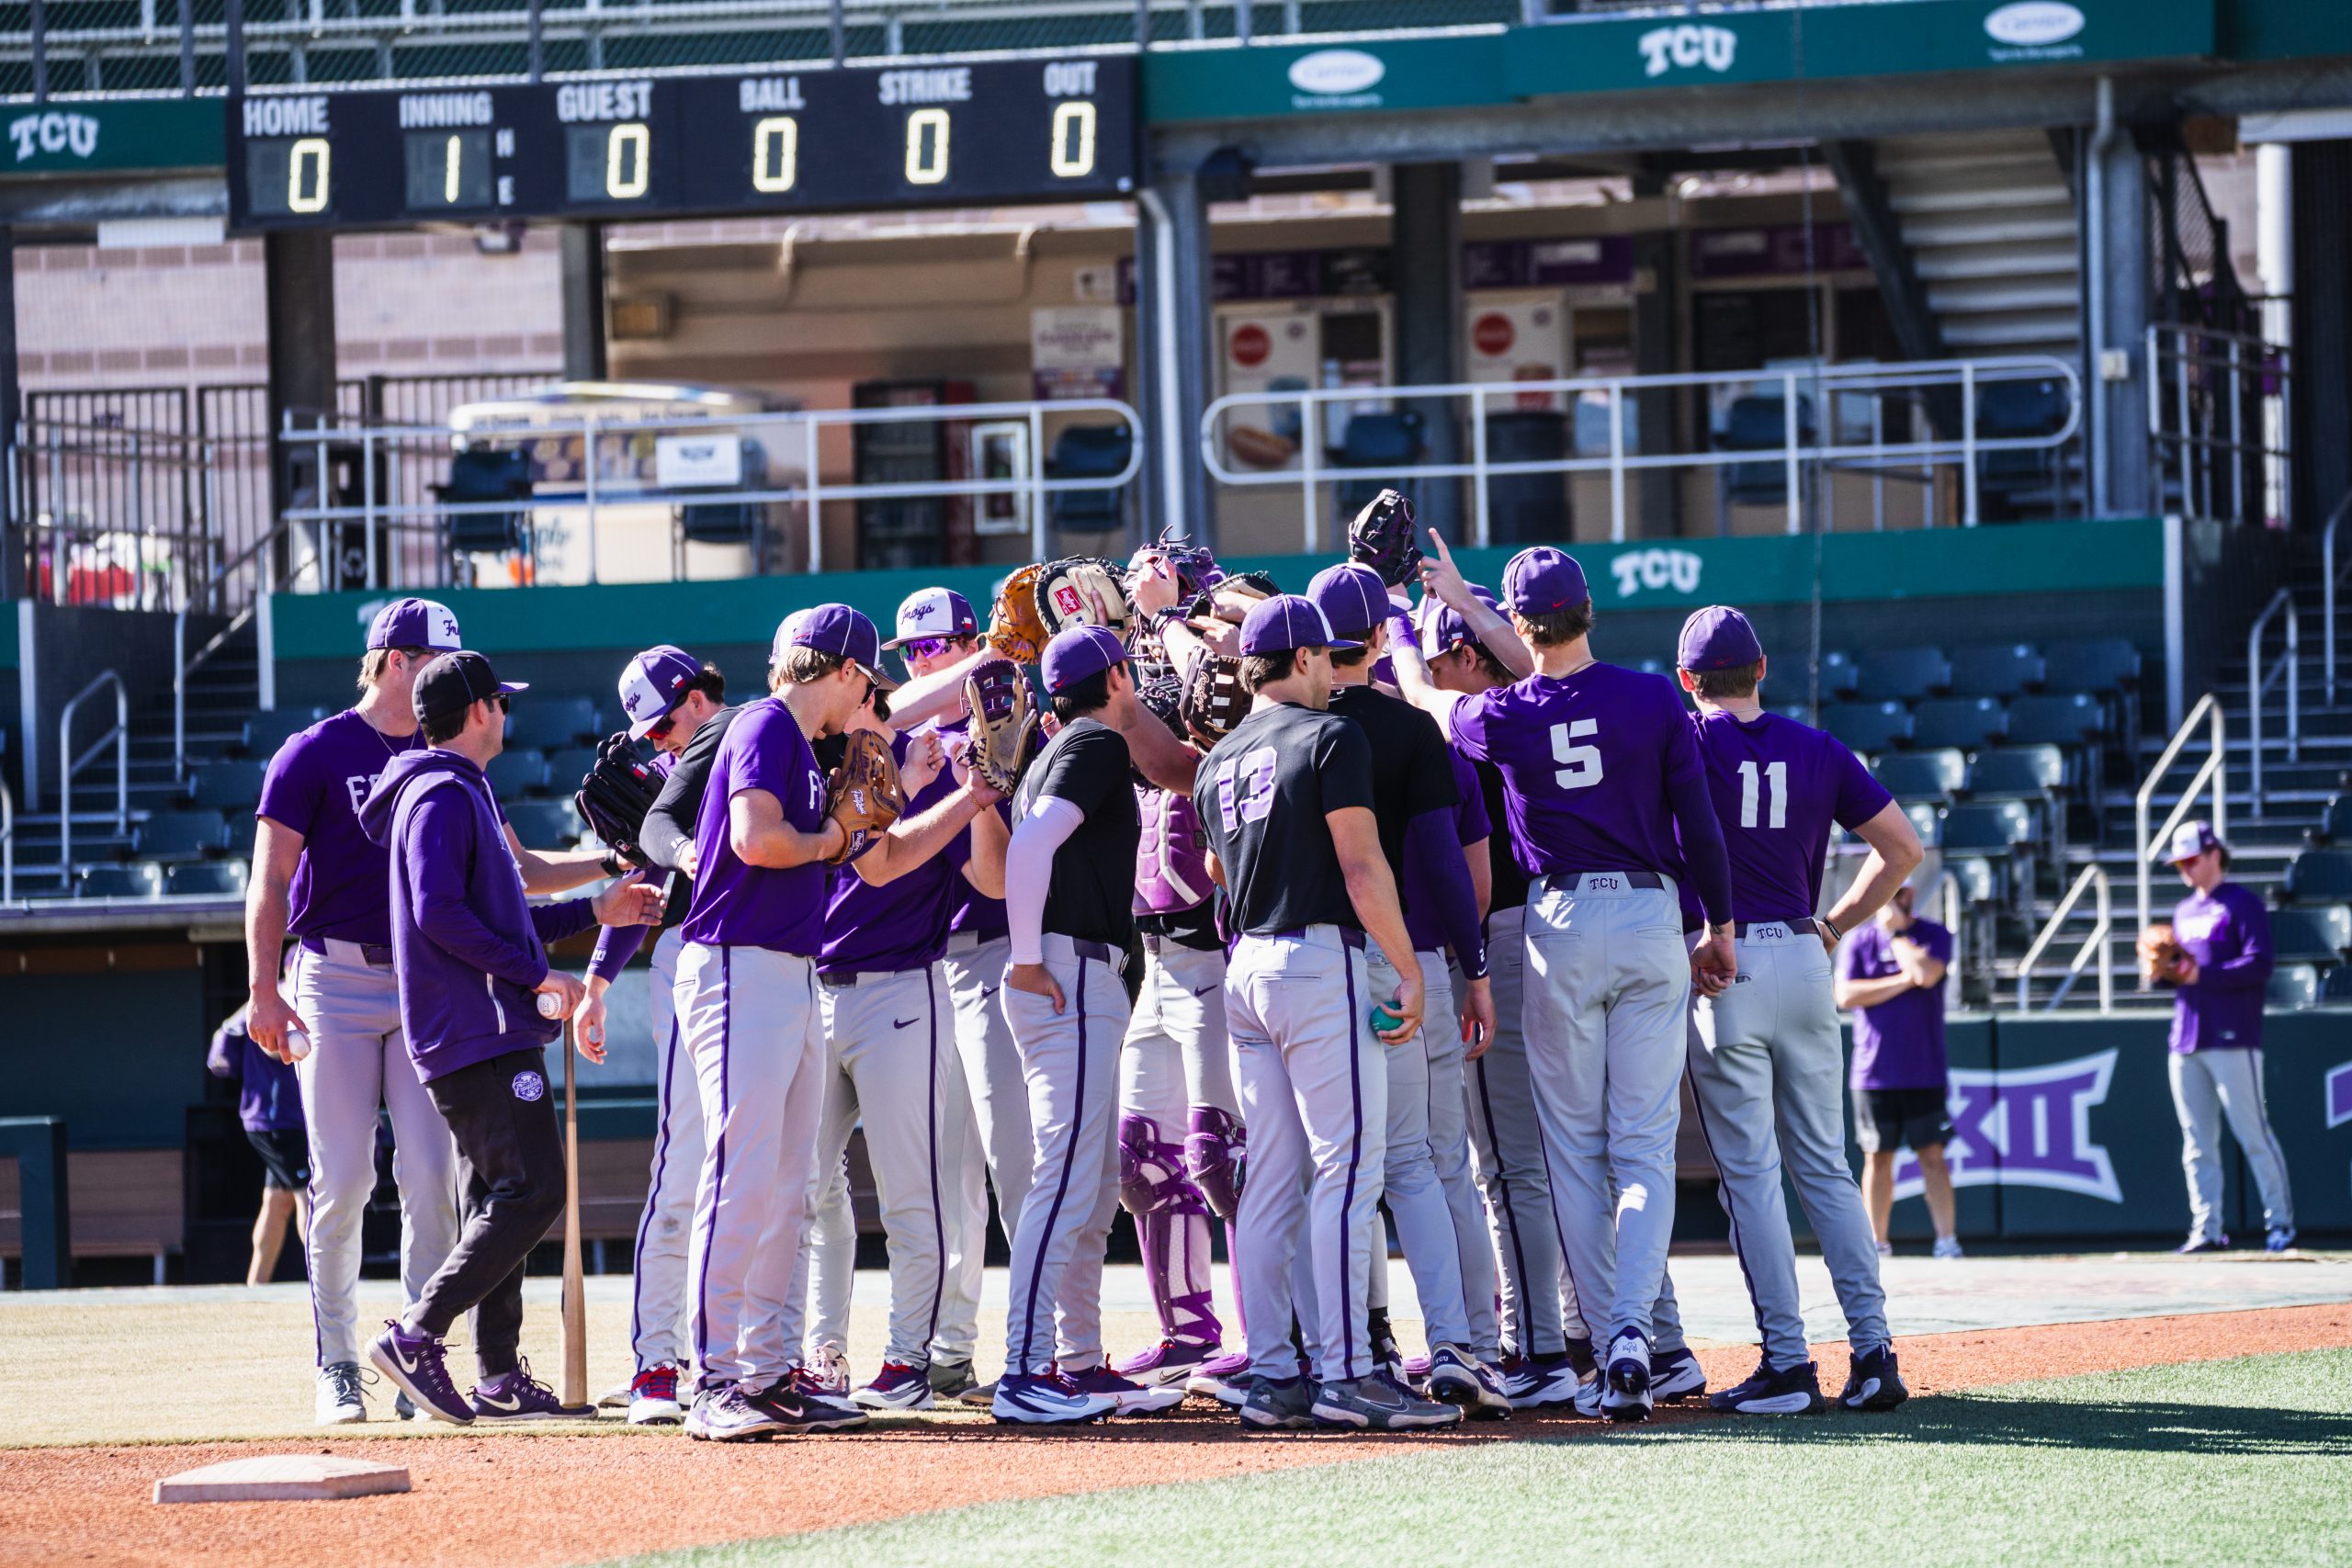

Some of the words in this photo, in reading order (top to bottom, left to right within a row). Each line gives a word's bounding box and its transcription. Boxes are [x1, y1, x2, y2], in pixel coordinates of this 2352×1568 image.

[1638, 24, 1737, 77] TCU
[557, 82, 653, 121] GUEST
[740, 77, 806, 112] BALL
[879, 67, 971, 105] STRIKE
[1044, 62, 1097, 96] OUT
[243, 96, 330, 136] HOME
[400, 91, 493, 128] INNING
[8, 111, 99, 164] TCU
[606, 124, 650, 198] 0
[752, 117, 797, 193] 0
[905, 108, 950, 185] 0
[1050, 101, 1096, 178] 0
[288, 138, 331, 212] 0
[445, 135, 461, 203] 1
[1611, 547, 1703, 598] TCU
[901, 604, 935, 626] Frogs
[1193, 671, 1209, 713] Rawlings
[1549, 717, 1604, 789] 5
[1213, 746, 1278, 833] 13
[1736, 761, 1788, 829] 11
[1589, 876, 1620, 891] TCU
[1755, 927, 1784, 941] TCU
[1435, 1356, 1450, 1365] TCU
